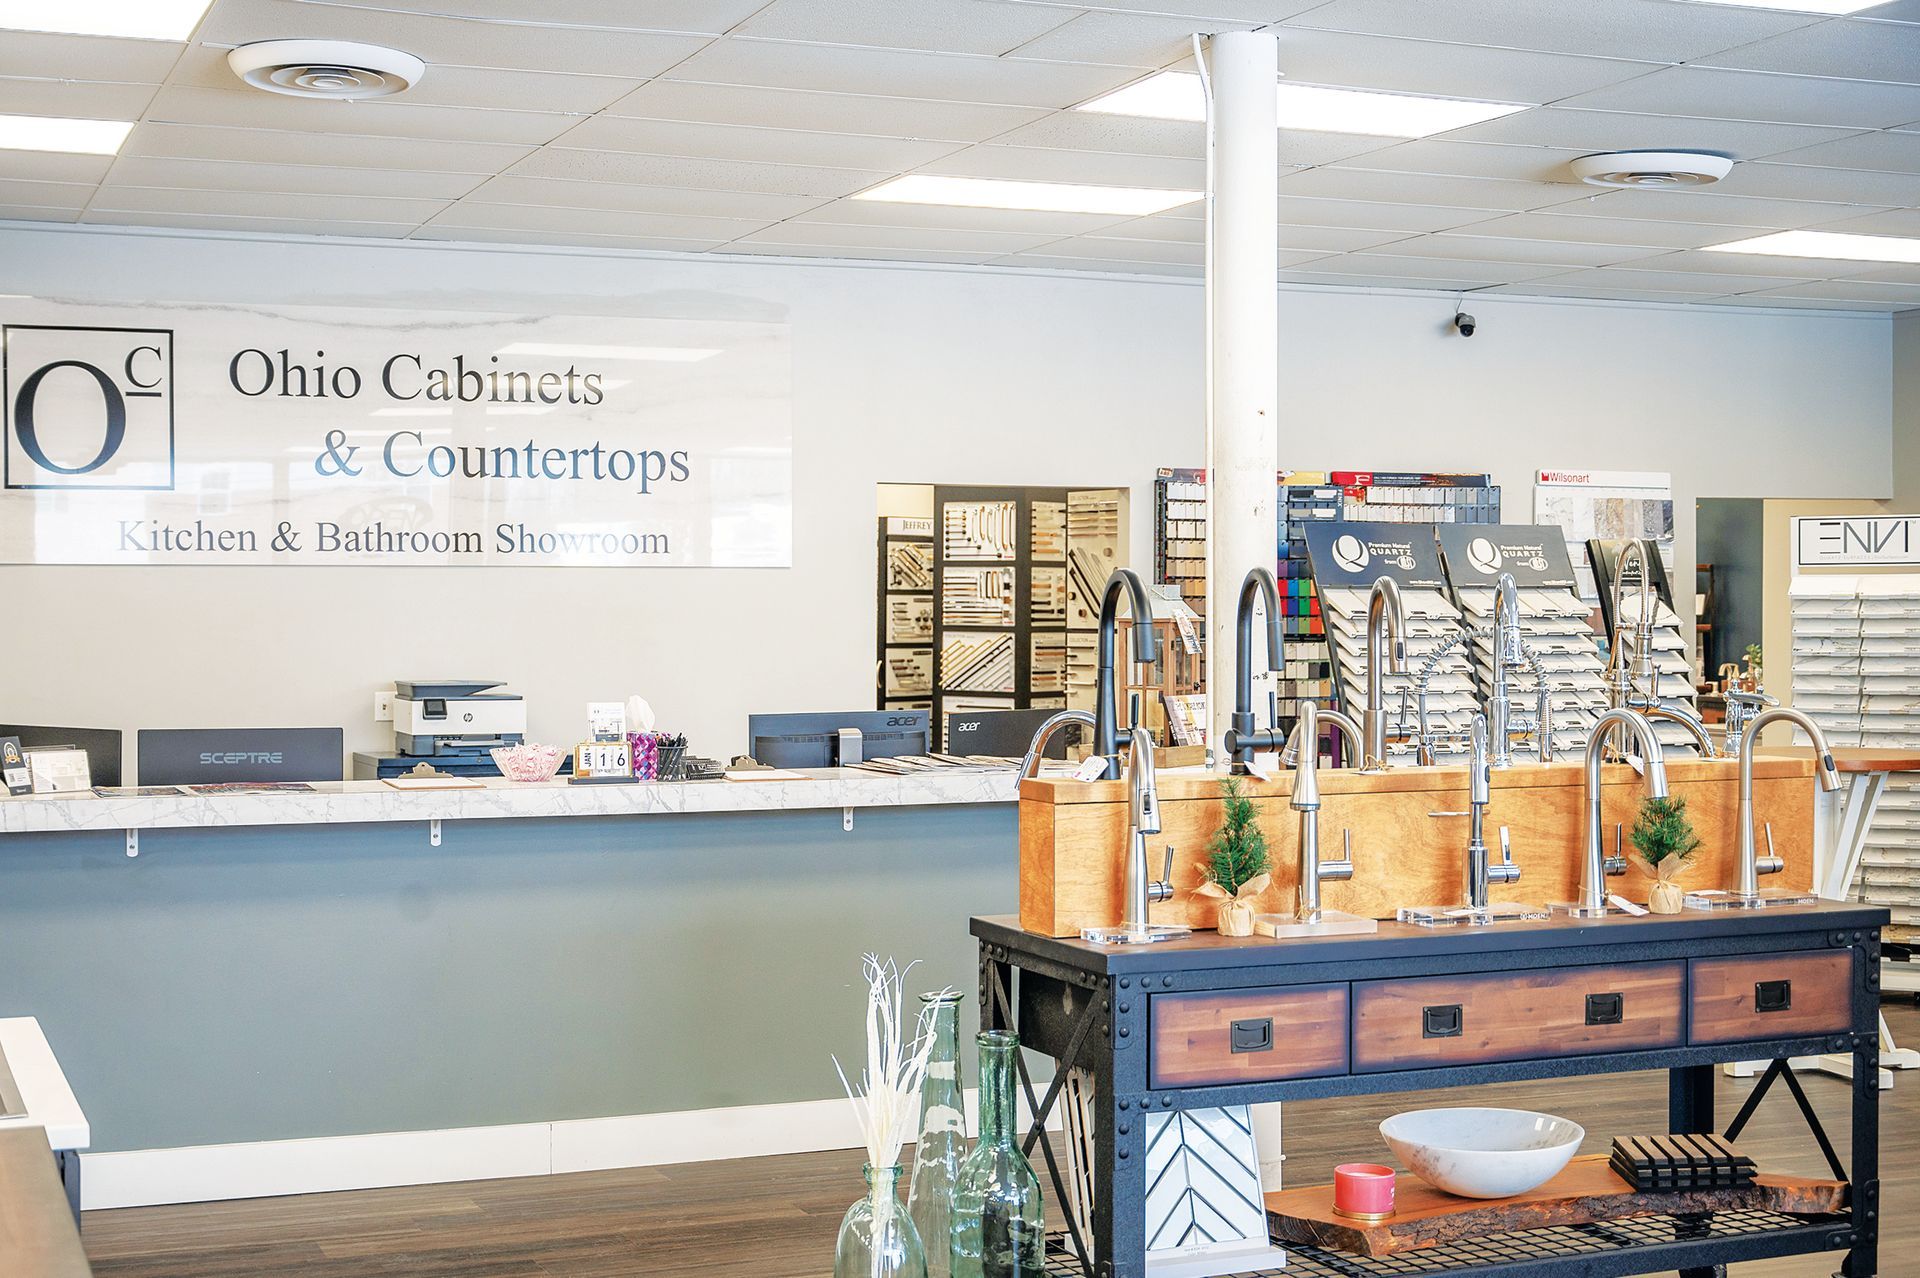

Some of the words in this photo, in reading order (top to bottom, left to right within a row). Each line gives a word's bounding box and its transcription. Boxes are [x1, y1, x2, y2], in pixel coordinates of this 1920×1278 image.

[229, 349, 361, 398] Ohio
[382, 353, 603, 405] Cabinets
[315, 428, 362, 478] &
[383, 430, 690, 494] Countertops
[1549, 472, 1590, 483] Wilsonart
[902, 520, 932, 531] JEFFREY
[119, 520, 258, 552] Kitchen
[270, 521, 302, 552] &
[315, 521, 483, 553] Bathroom
[496, 523, 670, 554] Showroom
[1819, 520, 1909, 554] ENVI
[1370, 548, 1412, 556] QUARTZ
[1502, 550, 1544, 558] QUARTZ
[887, 716, 922, 726] acer
[958, 722, 981, 731] acer
[200, 752, 283, 764] SCEPTRE
[584, 752, 592, 767] JAN
[600, 753, 606, 767] 1
[617, 752, 626, 767] 6
